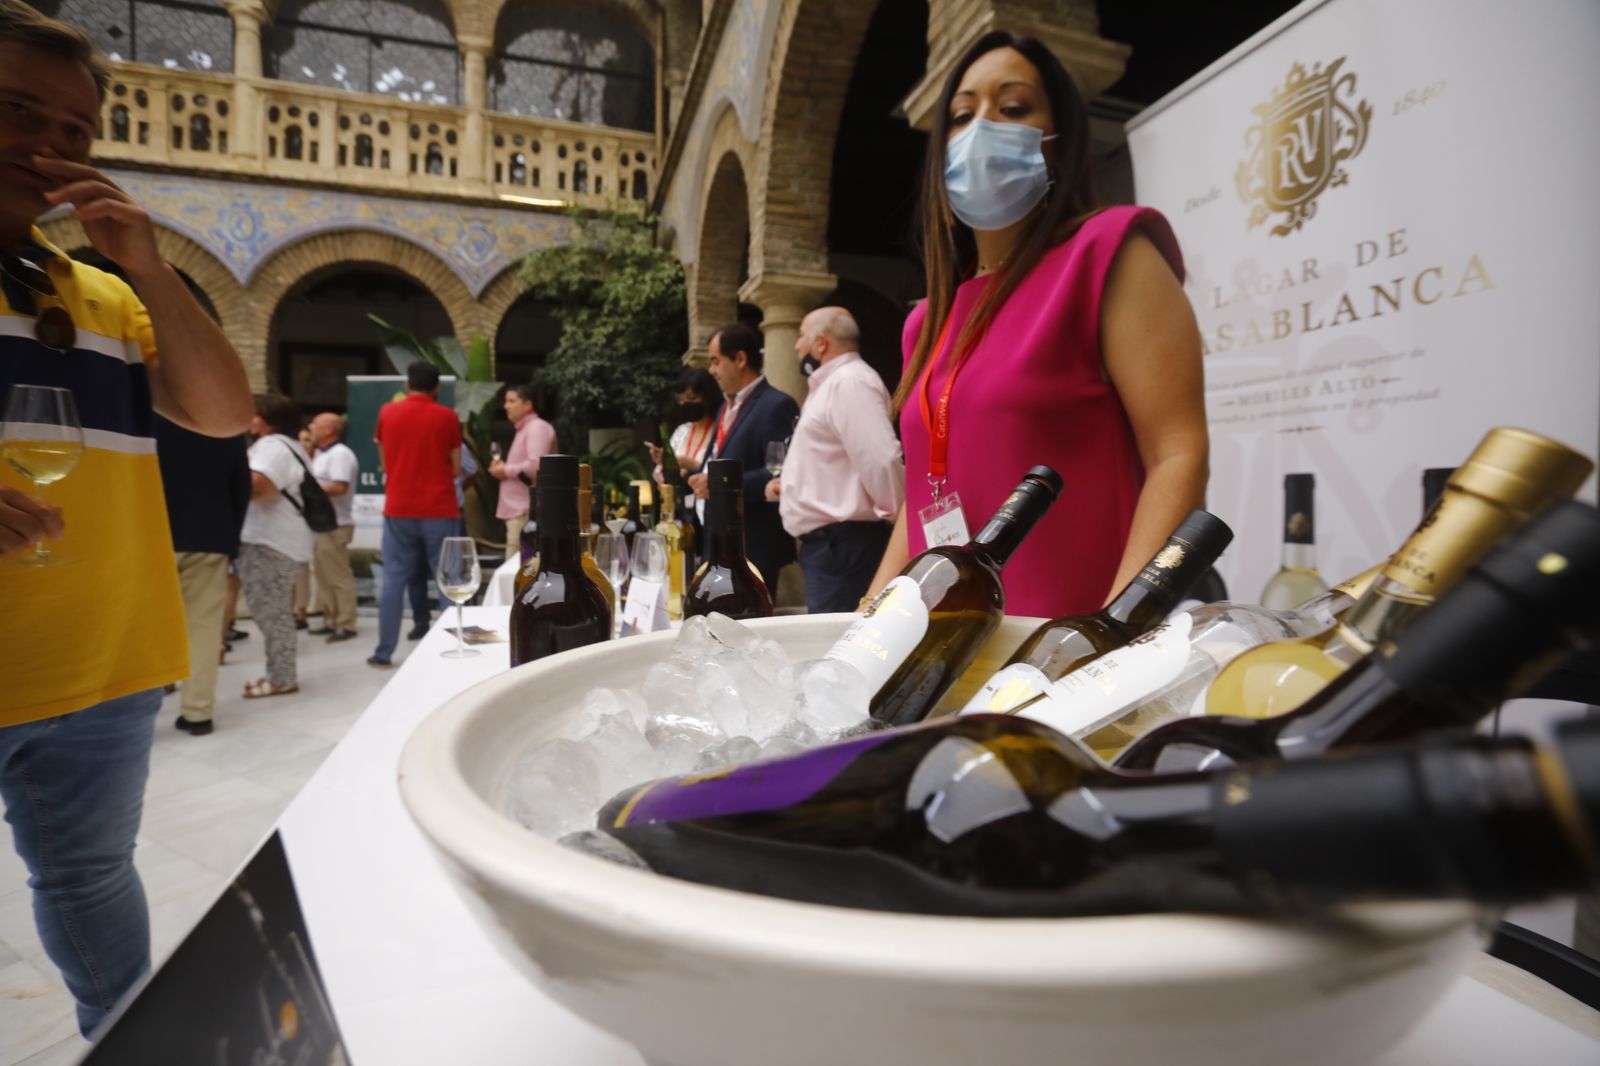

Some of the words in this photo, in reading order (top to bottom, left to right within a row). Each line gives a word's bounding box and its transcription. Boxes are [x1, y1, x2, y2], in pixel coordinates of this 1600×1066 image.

[1391, 79, 1448, 117] 1840
[1212, 257, 1321, 310] LAGAR
[1354, 228, 1410, 268] DE
[1319, 374, 1377, 397] ALTO
[360, 471, 379, 486] EL
